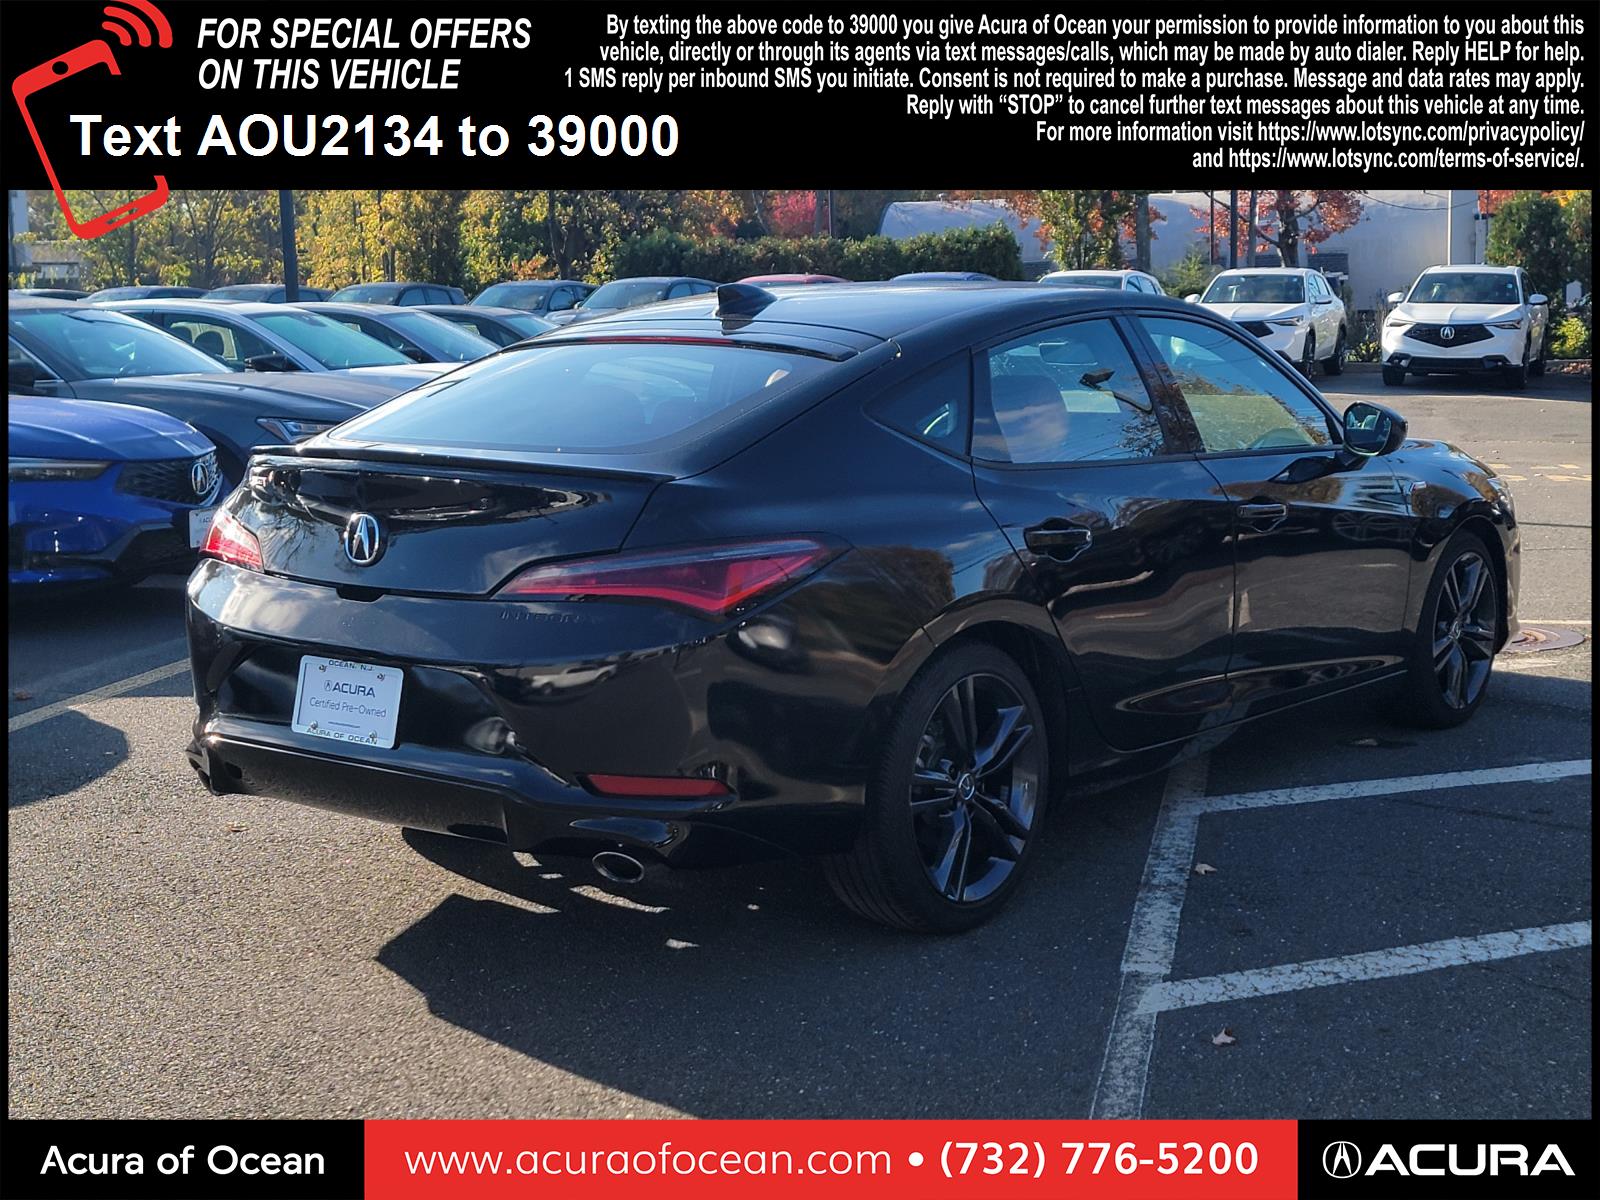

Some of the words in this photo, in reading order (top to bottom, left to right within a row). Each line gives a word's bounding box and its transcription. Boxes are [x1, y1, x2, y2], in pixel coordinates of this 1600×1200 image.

[332, 682, 376, 698] ACURA
[310, 697, 340, 711] Certified
[341, 701, 387, 718] Pre-Owned
[347, 734, 378, 745] OCEAN
